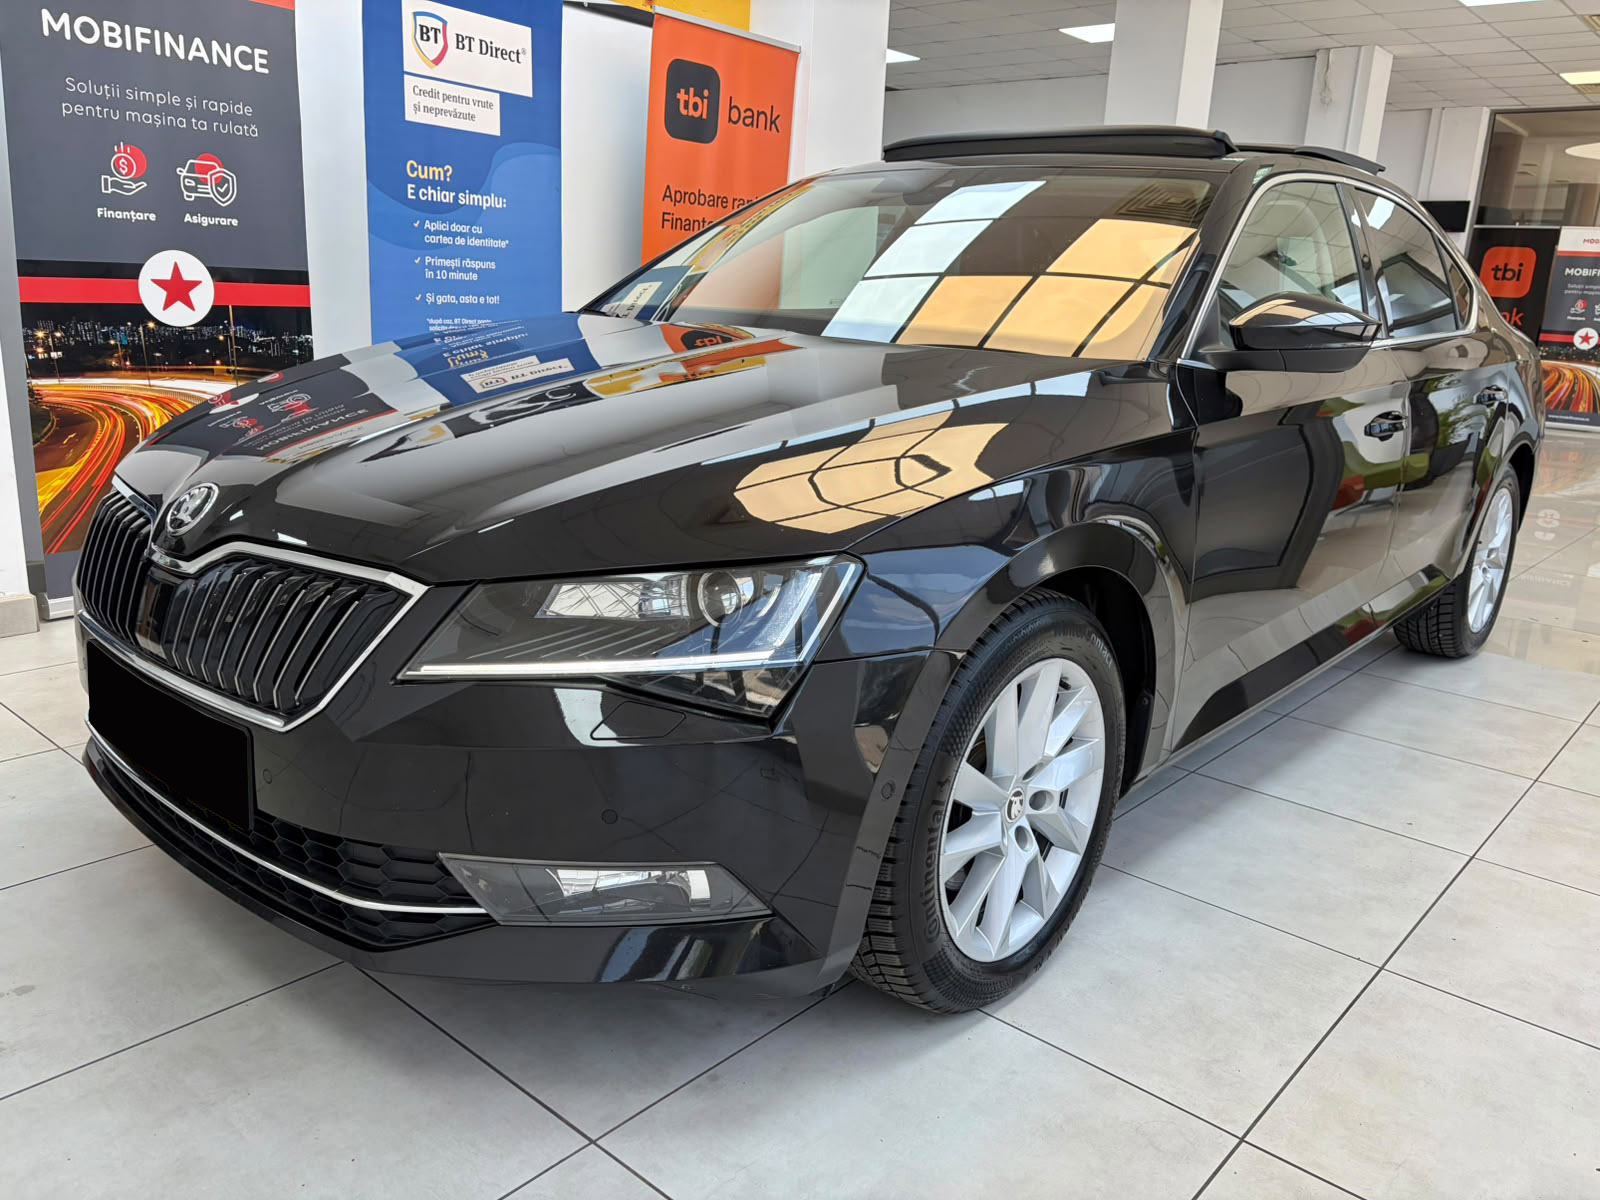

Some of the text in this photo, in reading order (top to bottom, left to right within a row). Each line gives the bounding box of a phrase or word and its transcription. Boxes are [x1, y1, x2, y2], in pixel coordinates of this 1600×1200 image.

[41, 9, 269, 74] MOBIFINANCE
[418, 24, 441, 44] BT
[454, 33, 474, 52] BT
[65, 77, 253, 116] Soluții simple și rapide
[412, 85, 494, 110] Credit pentru vrute
[676, 87, 709, 119] tbi
[62, 102, 258, 137] pentru mașina ta rulată
[413, 102, 476, 122] și neprevăzute
[728, 96, 781, 133] bank
[406, 160, 453, 182] Cum?
[407, 184, 507, 210] E chiar simplu:
[662, 184, 728, 209] Aprobare
[97, 208, 157, 222] Finanțare
[184, 213, 239, 226] Asigurare
[424, 220, 483, 234] Aplici doar cu
[424, 234, 453, 244] cartea
[455, 236, 466, 246] de
[425, 256, 496, 270] Primești răspuns
[1491, 262, 1524, 282] tbi
[425, 268, 478, 281] în 10 minute
[425, 293, 435, 305] Și
[436, 294, 458, 304] gata,
[459, 295, 478, 304] asta
[486, 295, 500, 305] tot!
